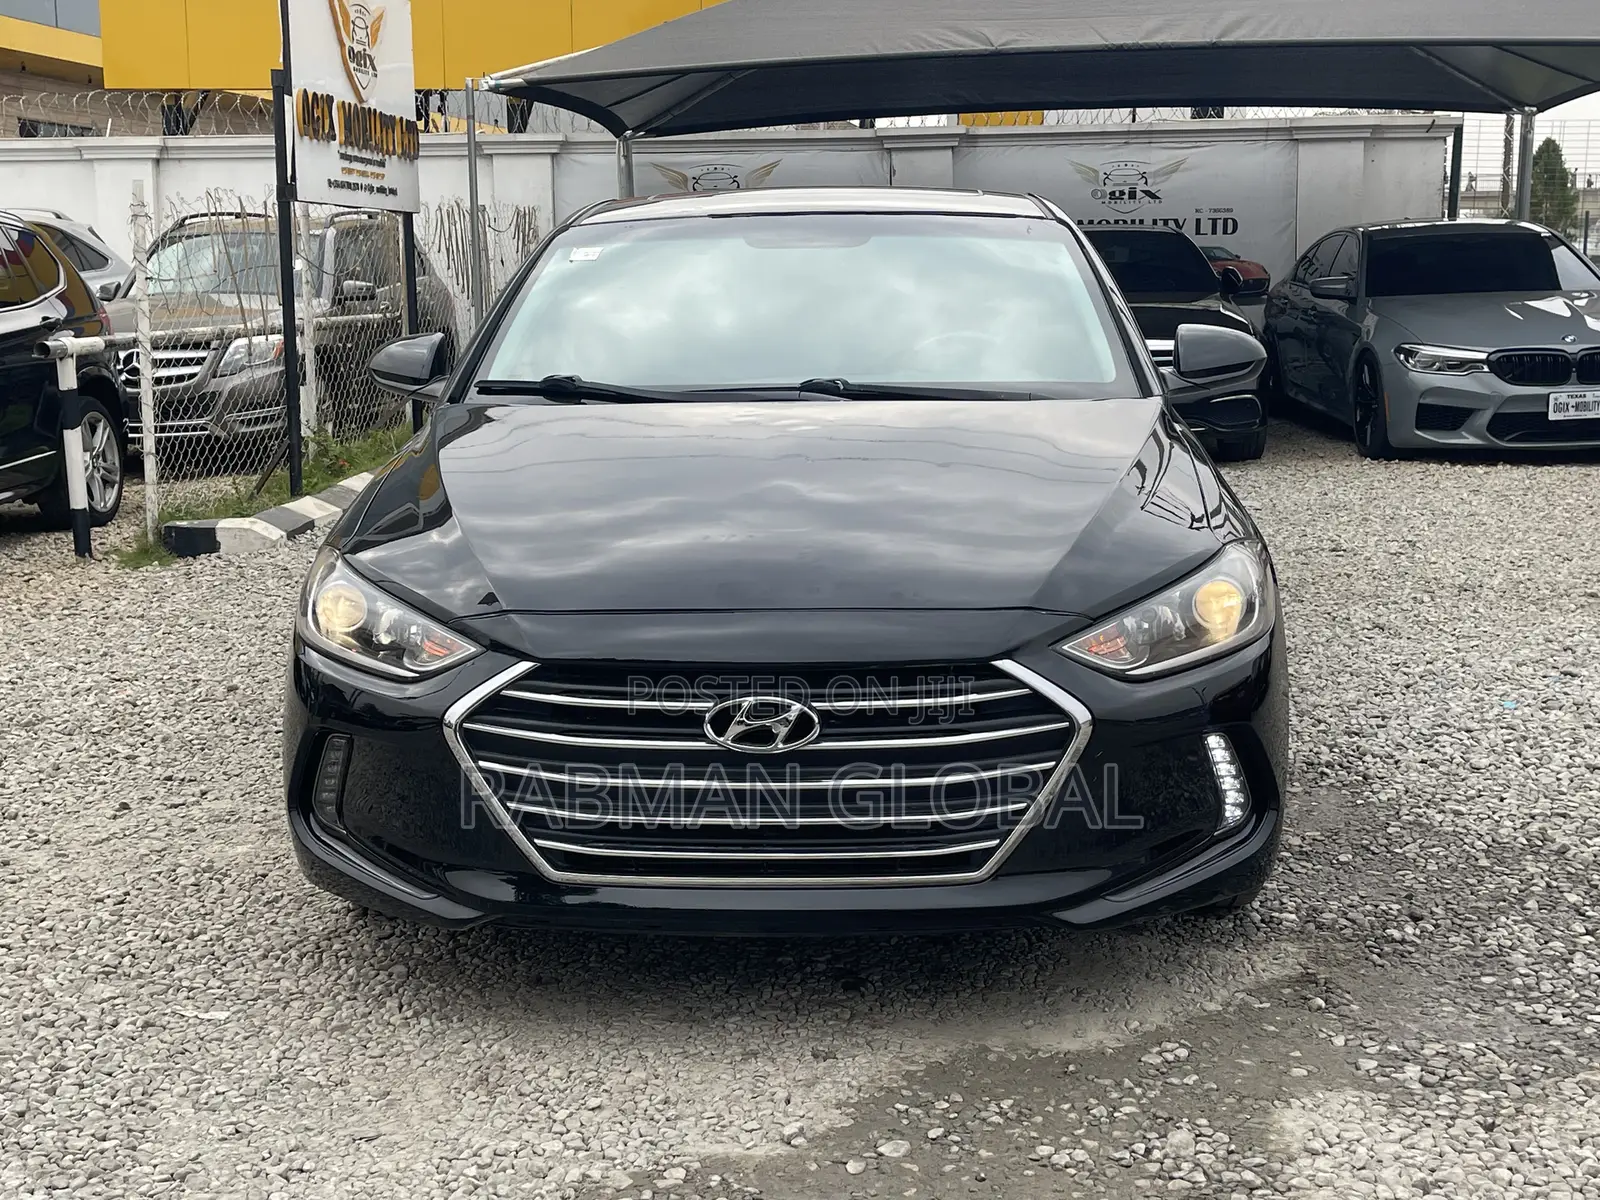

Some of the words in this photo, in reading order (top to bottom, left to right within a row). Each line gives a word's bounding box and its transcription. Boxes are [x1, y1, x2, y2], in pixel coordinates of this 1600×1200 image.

[296, 88, 336, 141] OGIX
[337, 100, 396, 157] MOBILITY
[1195, 218, 1239, 235] LTD
